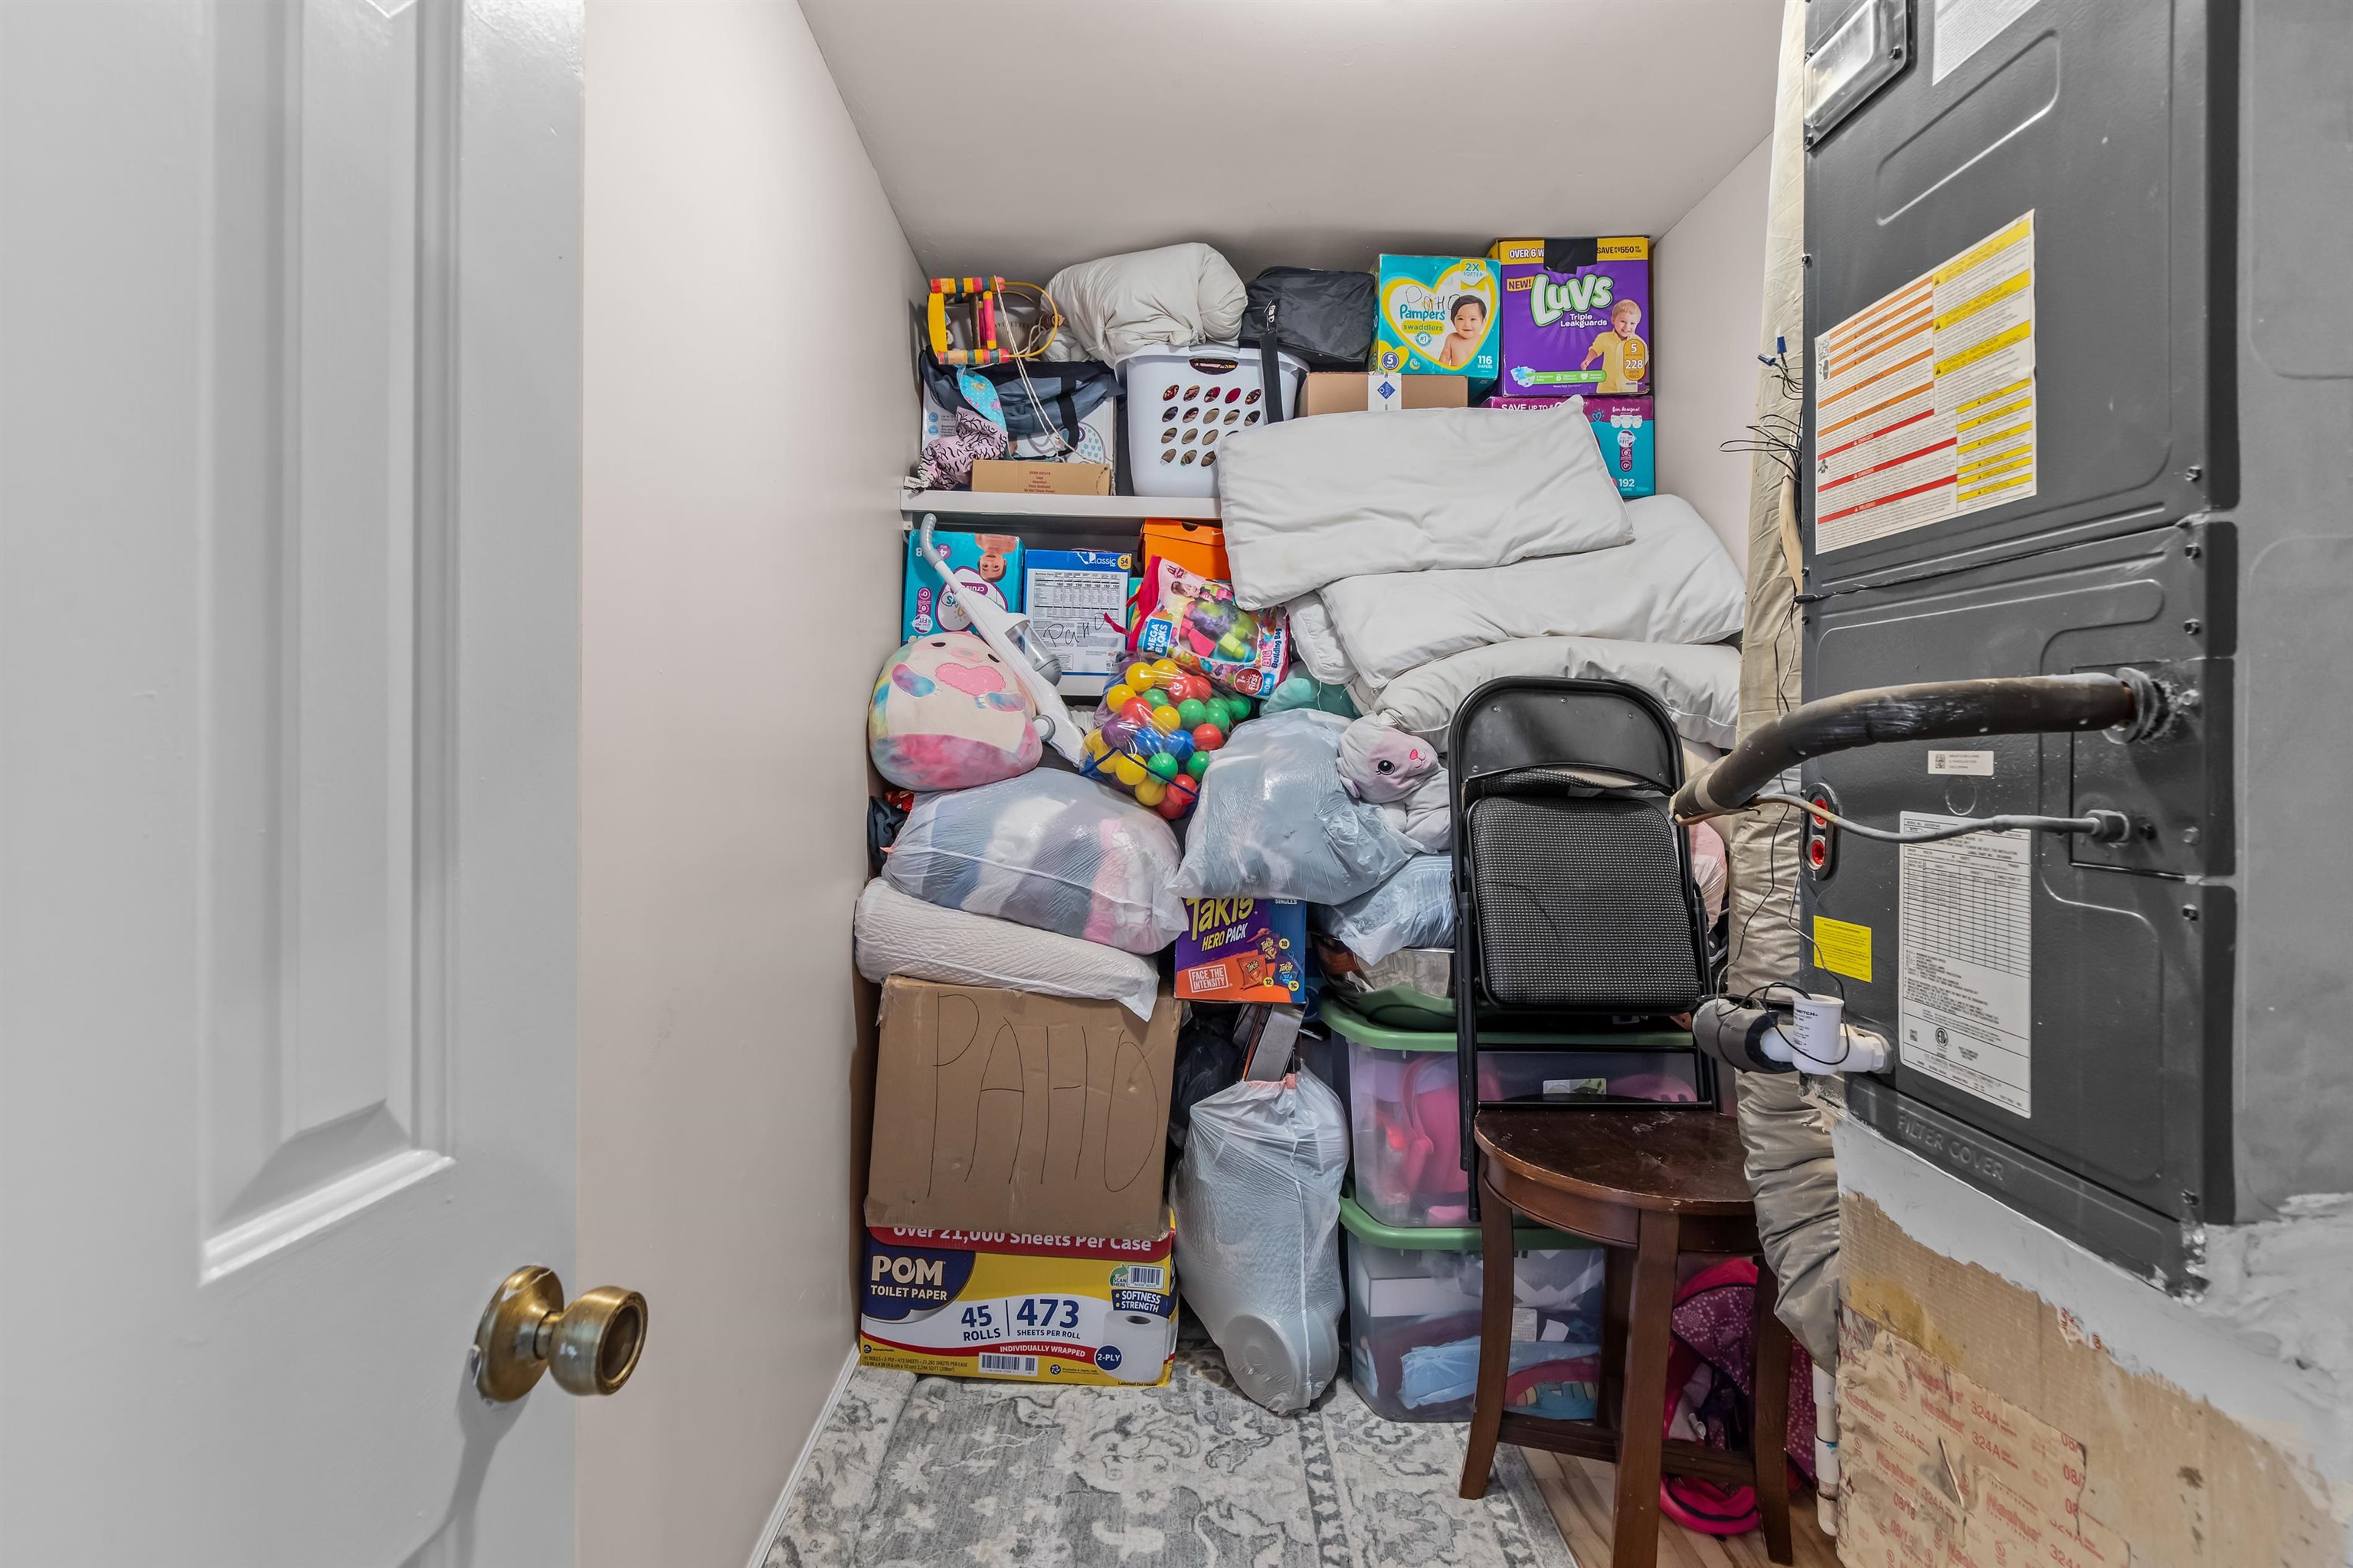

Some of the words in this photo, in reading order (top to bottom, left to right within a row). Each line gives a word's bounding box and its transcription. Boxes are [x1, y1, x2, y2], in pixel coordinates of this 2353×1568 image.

[1509, 248, 1530, 259] OVER
[1530, 248, 1536, 257] 6
[1465, 263, 1480, 272] 2X
[1508, 279, 1531, 290] NEW!
[1399, 304, 1445, 321] Pampers
[1402, 322, 1443, 332] swaddlers
[1560, 319, 1608, 328] Leakguards
[1630, 343, 1638, 353] 5
[1386, 355, 1394, 364] 5
[1478, 355, 1493, 364] 116
[1625, 359, 1644, 369] 228
[1618, 478, 1635, 487] 192
[1147, 624, 1160, 651] MEGA
[1154, 624, 1168, 653] BLOKS
[1274, 628, 1283, 640] Bag
[1261, 650, 1272, 667] BIG
[1271, 640, 1282, 669] Building
[1201, 931, 1225, 952] HERO
[1226, 922, 1248, 944] PACK
[1192, 969, 1209, 981] FACE
[1209, 967, 1224, 978] THE
[1193, 977, 1225, 990] INTENSITY
[1897, 1114, 1943, 1151] FILTER
[1949, 1141, 2004, 1181] COVER
[893, 1227, 935, 1238] Over
[1010, 1232, 1072, 1247] Sheets
[1075, 1236, 1106, 1249] Per
[1111, 1238, 1152, 1252] Case
[870, 1255, 944, 1287] POM
[870, 1285, 909, 1298] TOILET
[911, 1290, 947, 1301] PAPER
[1121, 1291, 1161, 1304] SOFTNESS
[1016, 1298, 1080, 1329] 473
[1121, 1301, 1160, 1313] STRENGTH
[961, 1304, 993, 1328] 45
[963, 1327, 1001, 1341] ROLLS
[1062, 1331, 1081, 1340] ROLL
[1000, 1345, 1050, 1354] INDIVIDUALLY
[1050, 1346, 1085, 1358] WRAPPED
[1971, 1399, 2001, 1429] 324A
[1893, 1421, 1918, 1447] 324A
[1972, 1431, 2001, 1460] 324A
